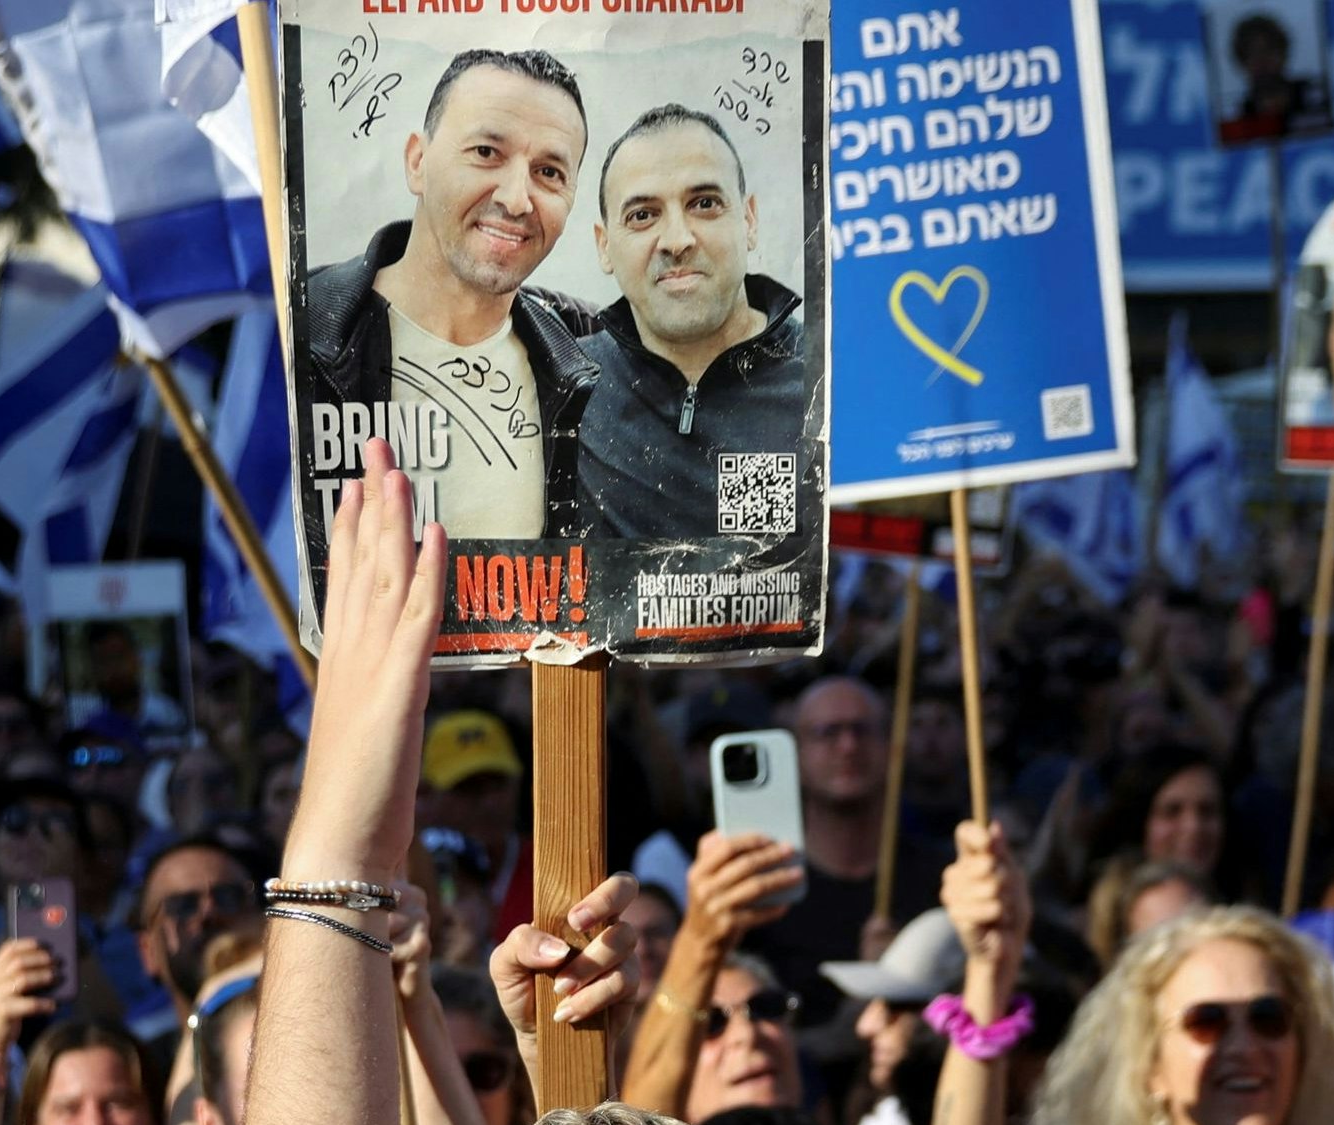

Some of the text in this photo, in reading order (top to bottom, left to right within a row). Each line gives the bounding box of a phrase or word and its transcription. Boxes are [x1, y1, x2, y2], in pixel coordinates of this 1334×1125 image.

[859, 8, 963, 59] אתם
[897, 45, 1063, 106] הנשימה
[924, 94, 1054, 151] שלהם
[834, 150, 1022, 211] מאושרים
[922, 193, 1058, 249] שאתם
[312, 401, 449, 471] BRING
[315, 476, 439, 543] TM
[456, 545, 585, 622] NOW!
[637, 571, 801, 597] HOSTAGES AND MISSING
[638, 594, 800, 629] FAMILIES FORUM
